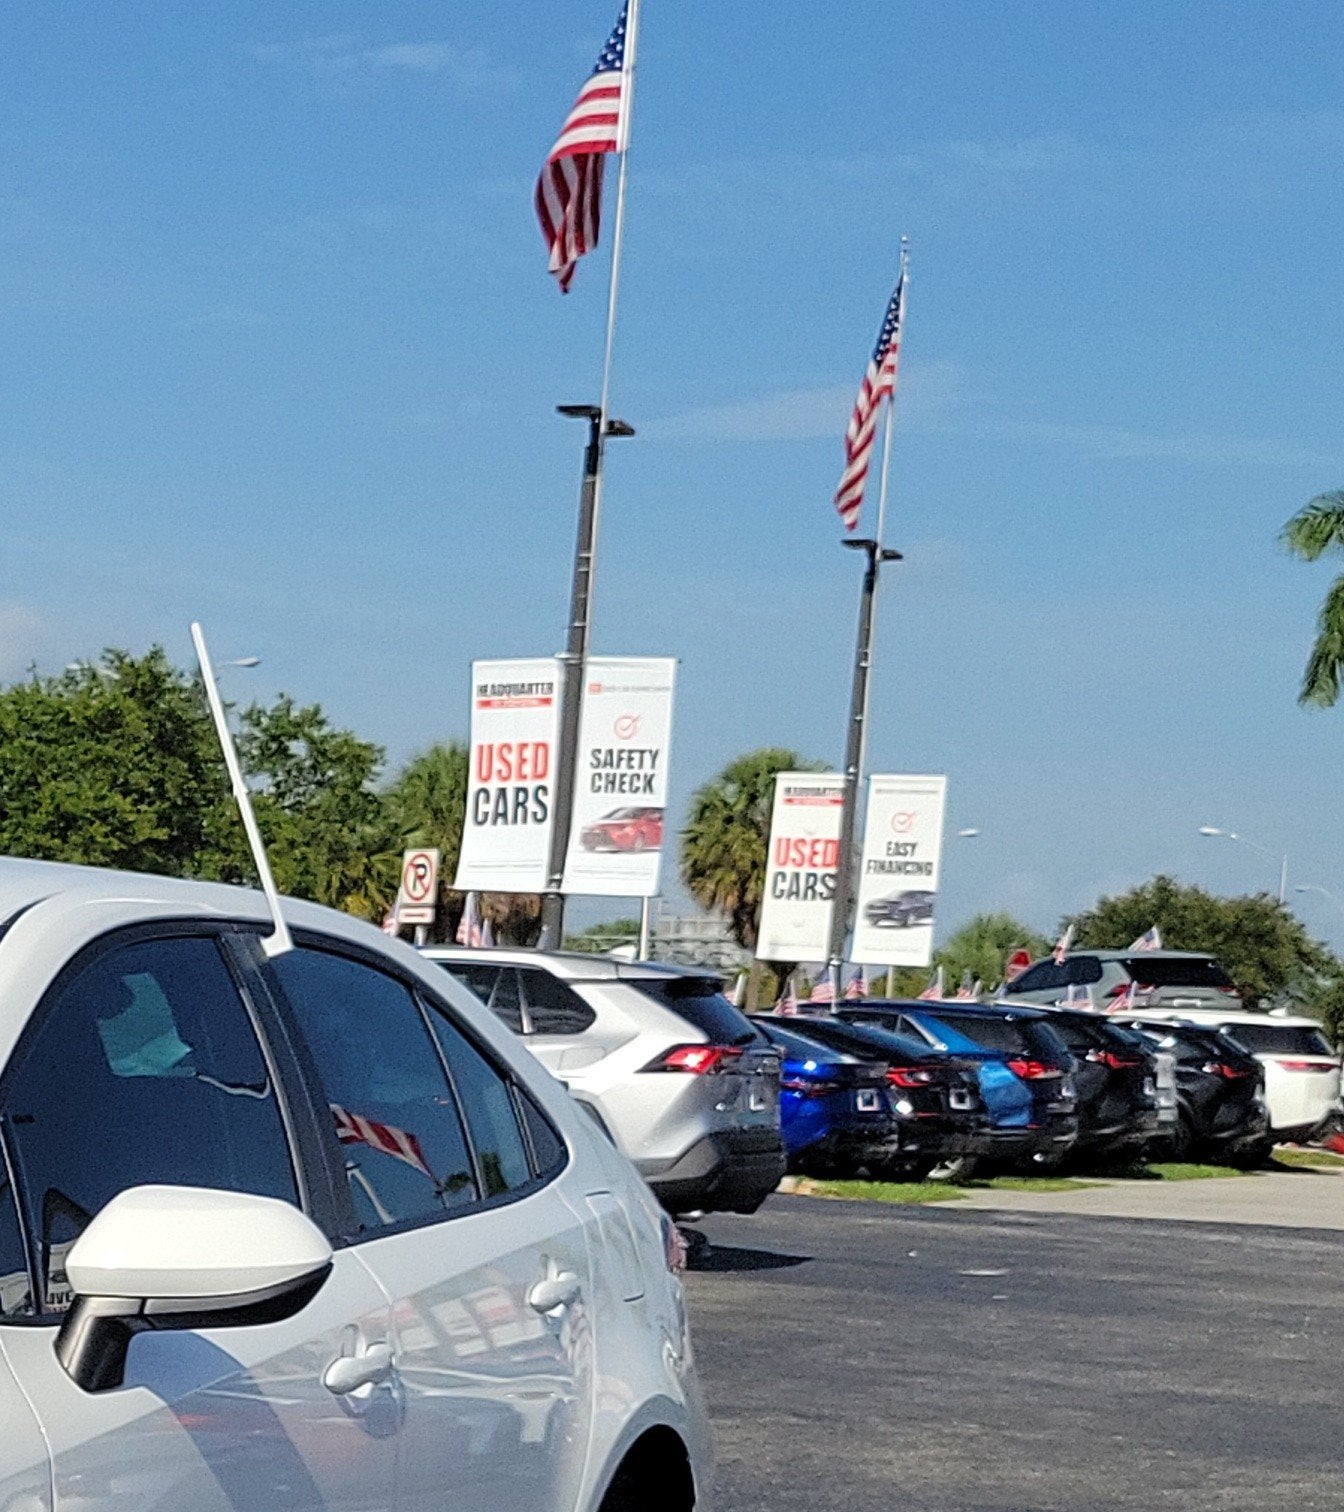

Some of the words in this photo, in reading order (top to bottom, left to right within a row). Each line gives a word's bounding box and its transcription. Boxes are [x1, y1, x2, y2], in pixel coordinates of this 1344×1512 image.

[476, 742, 550, 782] USED
[590, 748, 661, 769] SAFETY
[590, 772, 656, 794] CHECK
[473, 785, 549, 826] CARS
[775, 837, 841, 869] USED
[885, 840, 919, 858] EASY
[865, 859, 935, 876] FINANCING
[772, 871, 837, 901] CARS
